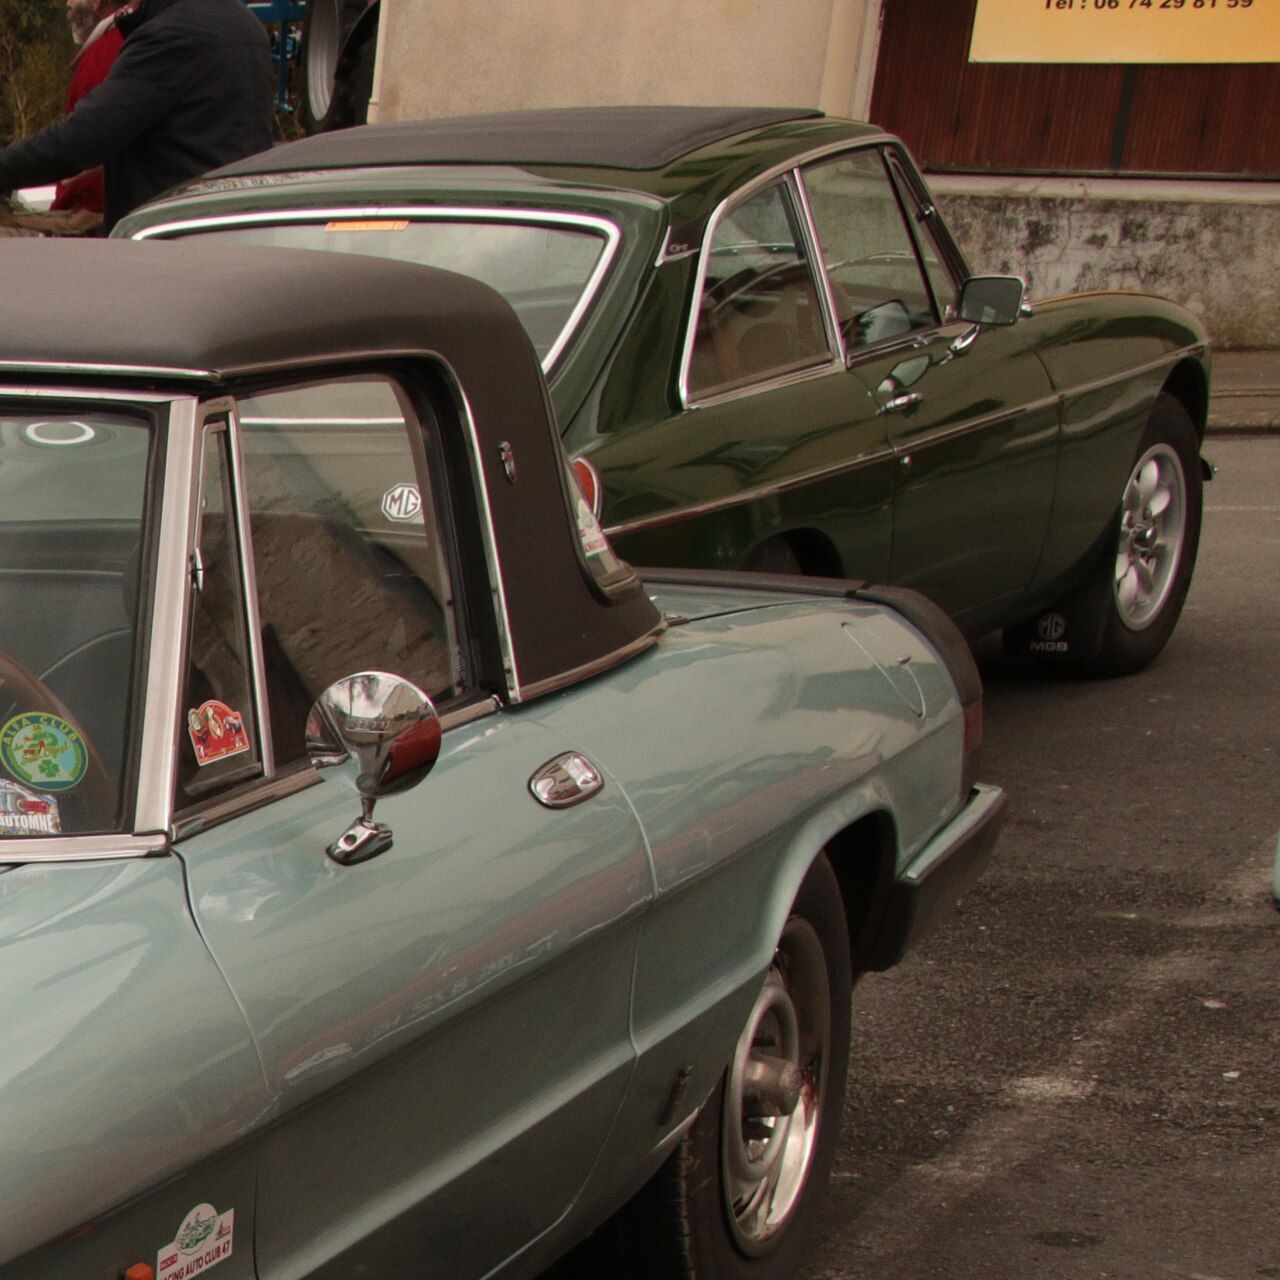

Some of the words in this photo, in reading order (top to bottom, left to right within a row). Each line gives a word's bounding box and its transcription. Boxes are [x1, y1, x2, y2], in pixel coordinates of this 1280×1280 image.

[389, 489, 419, 516] MG
[1030, 642, 1068, 651] MGB
[3, 718, 31, 744] ALFA
[41, 715, 78, 741] CLUB
[185, 1256, 204, 1277] AUTO
[204, 1246, 221, 1265] CLUB
[222, 1239, 231, 1254] 47
